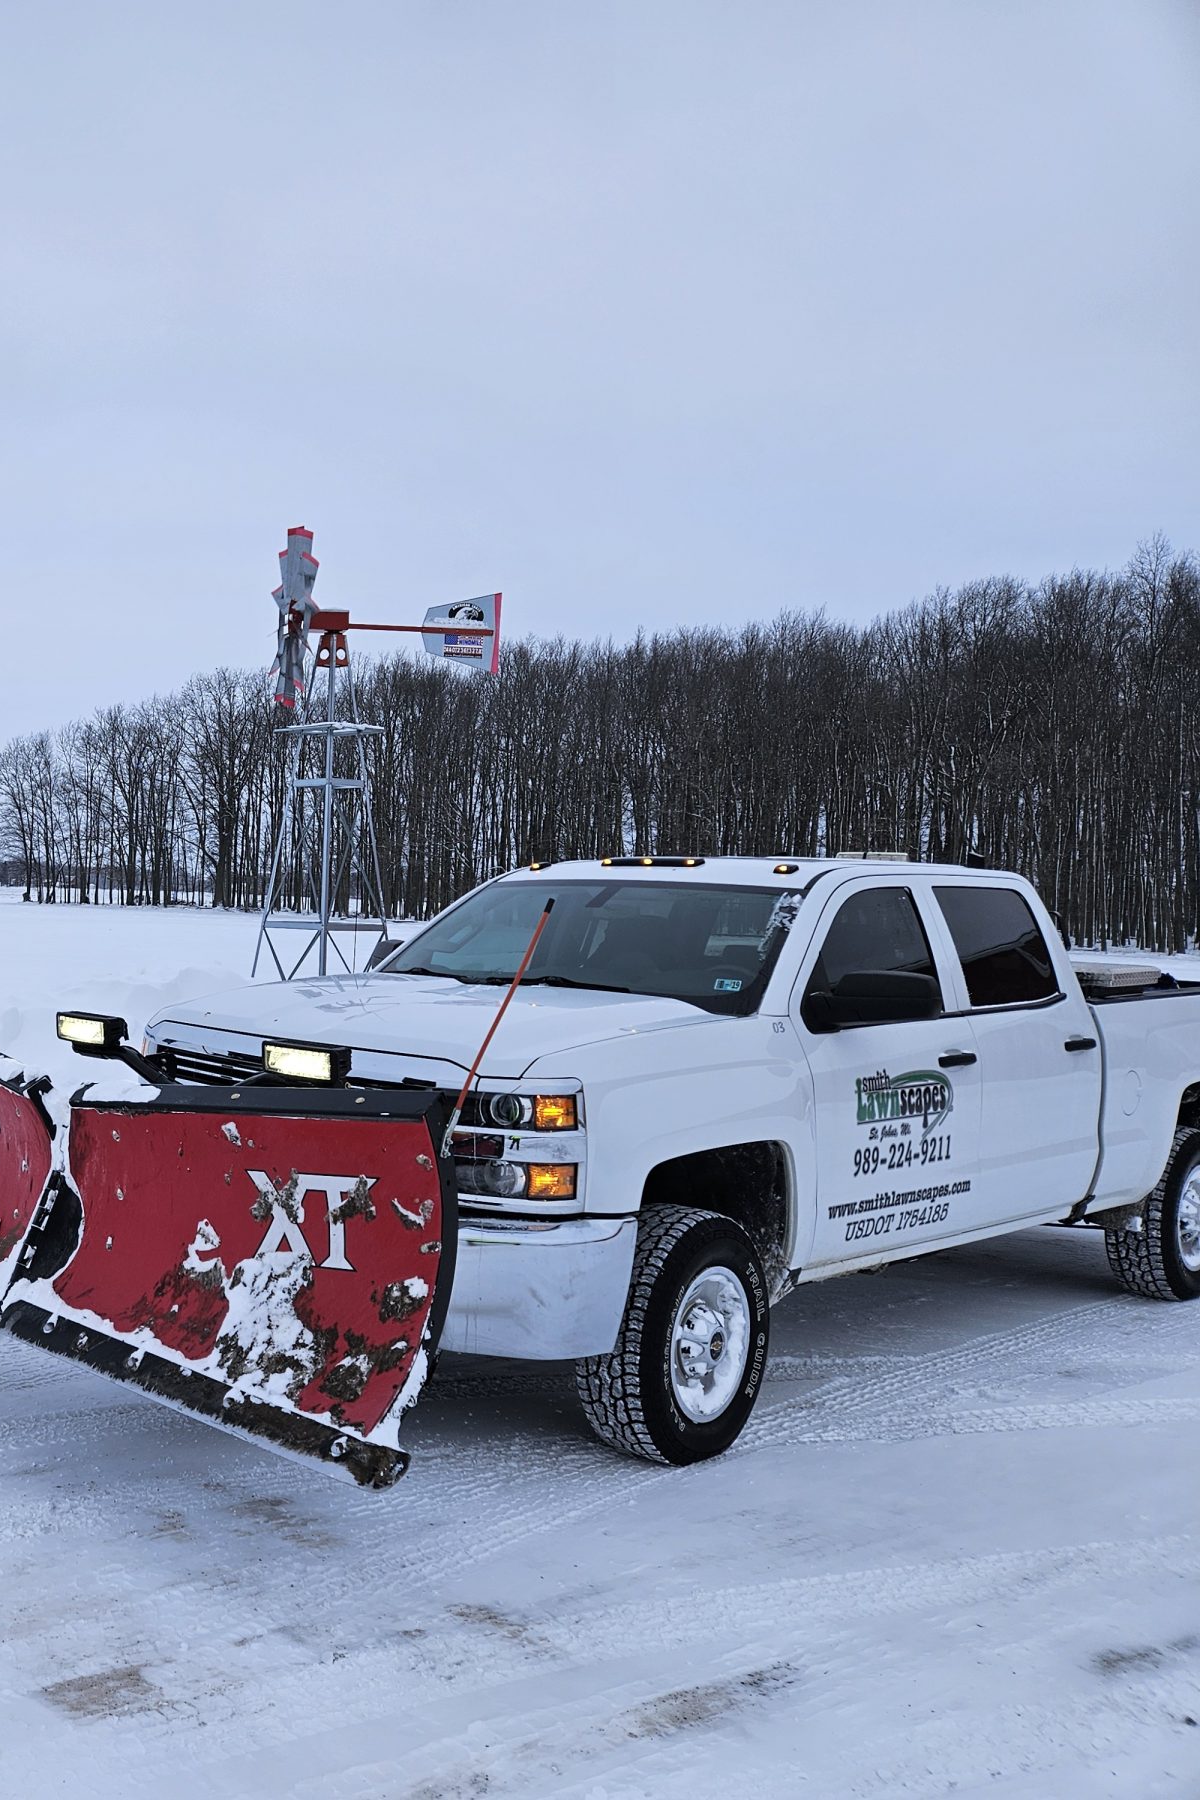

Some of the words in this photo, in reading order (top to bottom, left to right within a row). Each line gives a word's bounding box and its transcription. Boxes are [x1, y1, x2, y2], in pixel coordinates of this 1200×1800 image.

[772, 1021, 785, 1034] 03
[862, 1068, 892, 1093] smith
[853, 1135, 951, 1177] 989-224-9211
[245, 1169, 381, 1272] XT
[828, 1180, 971, 1220] www.smithlawnscapes.com
[845, 1213, 895, 1242] USDOT
[895, 1203, 950, 1231] 1754185
[745, 1262, 766, 1322] TRAIL
[744, 1331, 766, 1398] GUIDE
